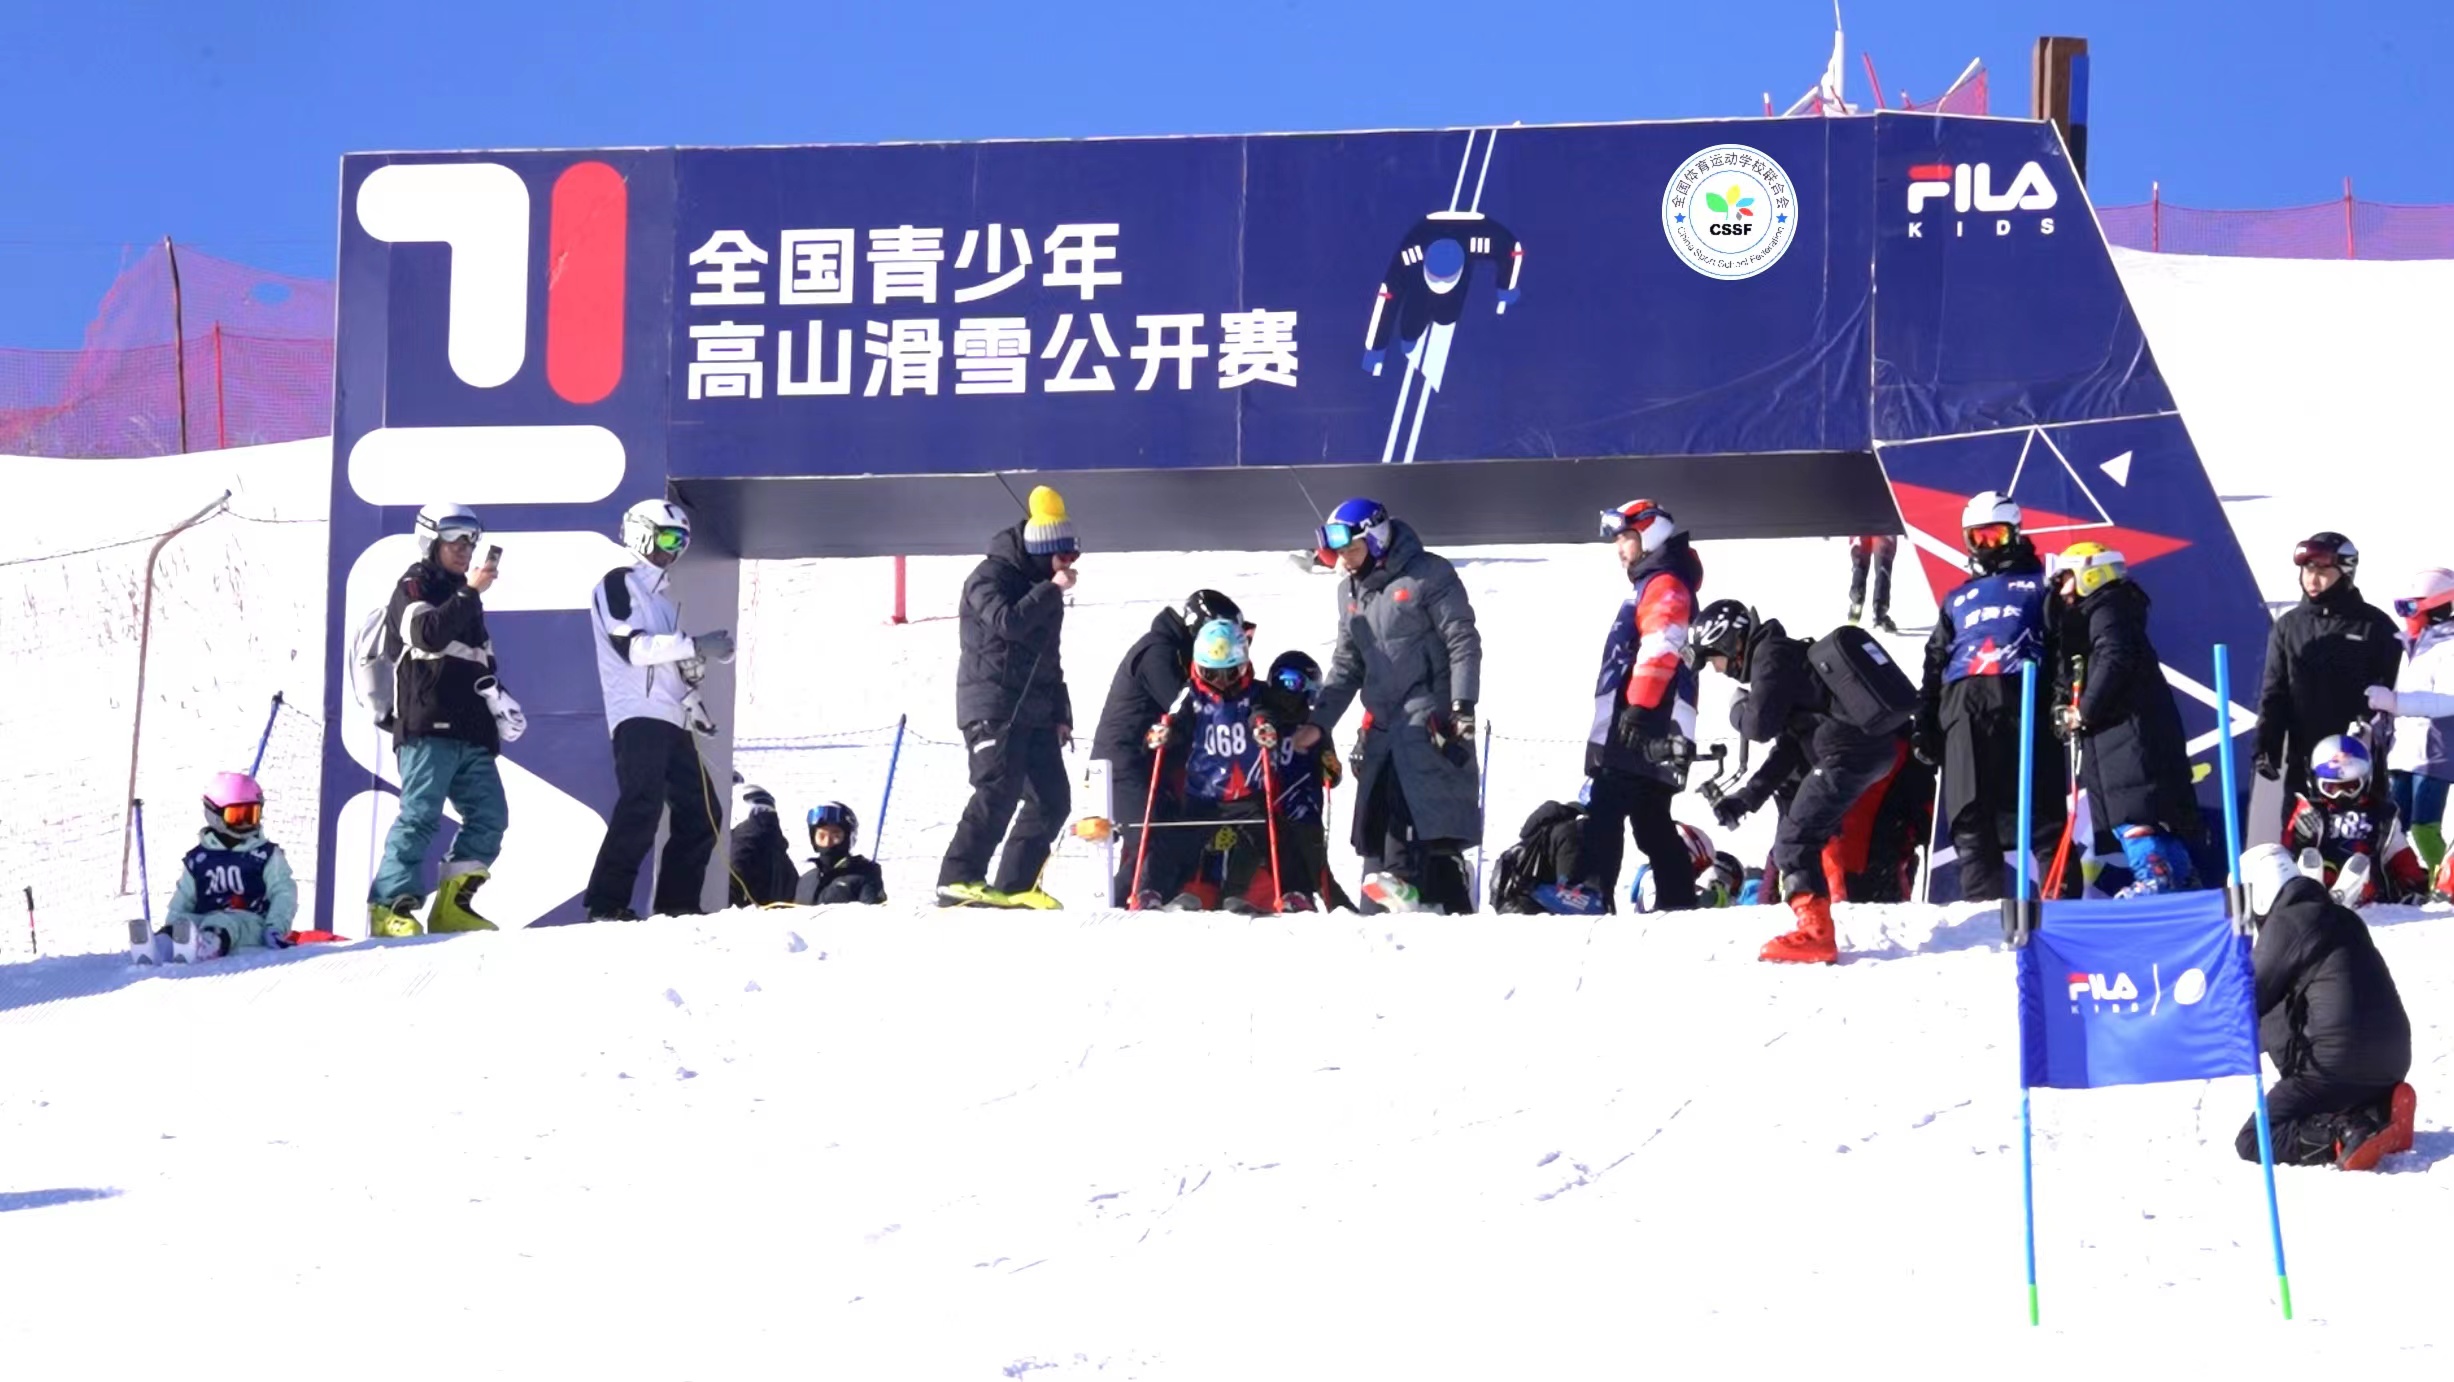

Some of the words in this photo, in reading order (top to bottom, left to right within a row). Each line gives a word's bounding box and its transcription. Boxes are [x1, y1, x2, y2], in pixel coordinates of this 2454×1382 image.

[1671, 152, 1789, 209] 全国体育运动学校联合会
[1907, 161, 2058, 214] FILA
[1709, 223, 1752, 236] CSSF
[1908, 218, 2055, 238] KIDS
[690, 224, 1121, 305] 全国青少年
[688, 309, 1298, 399] 高山滑雪公开赛
[1203, 722, 1247, 757] 068
[2068, 972, 2139, 1001] FILA
